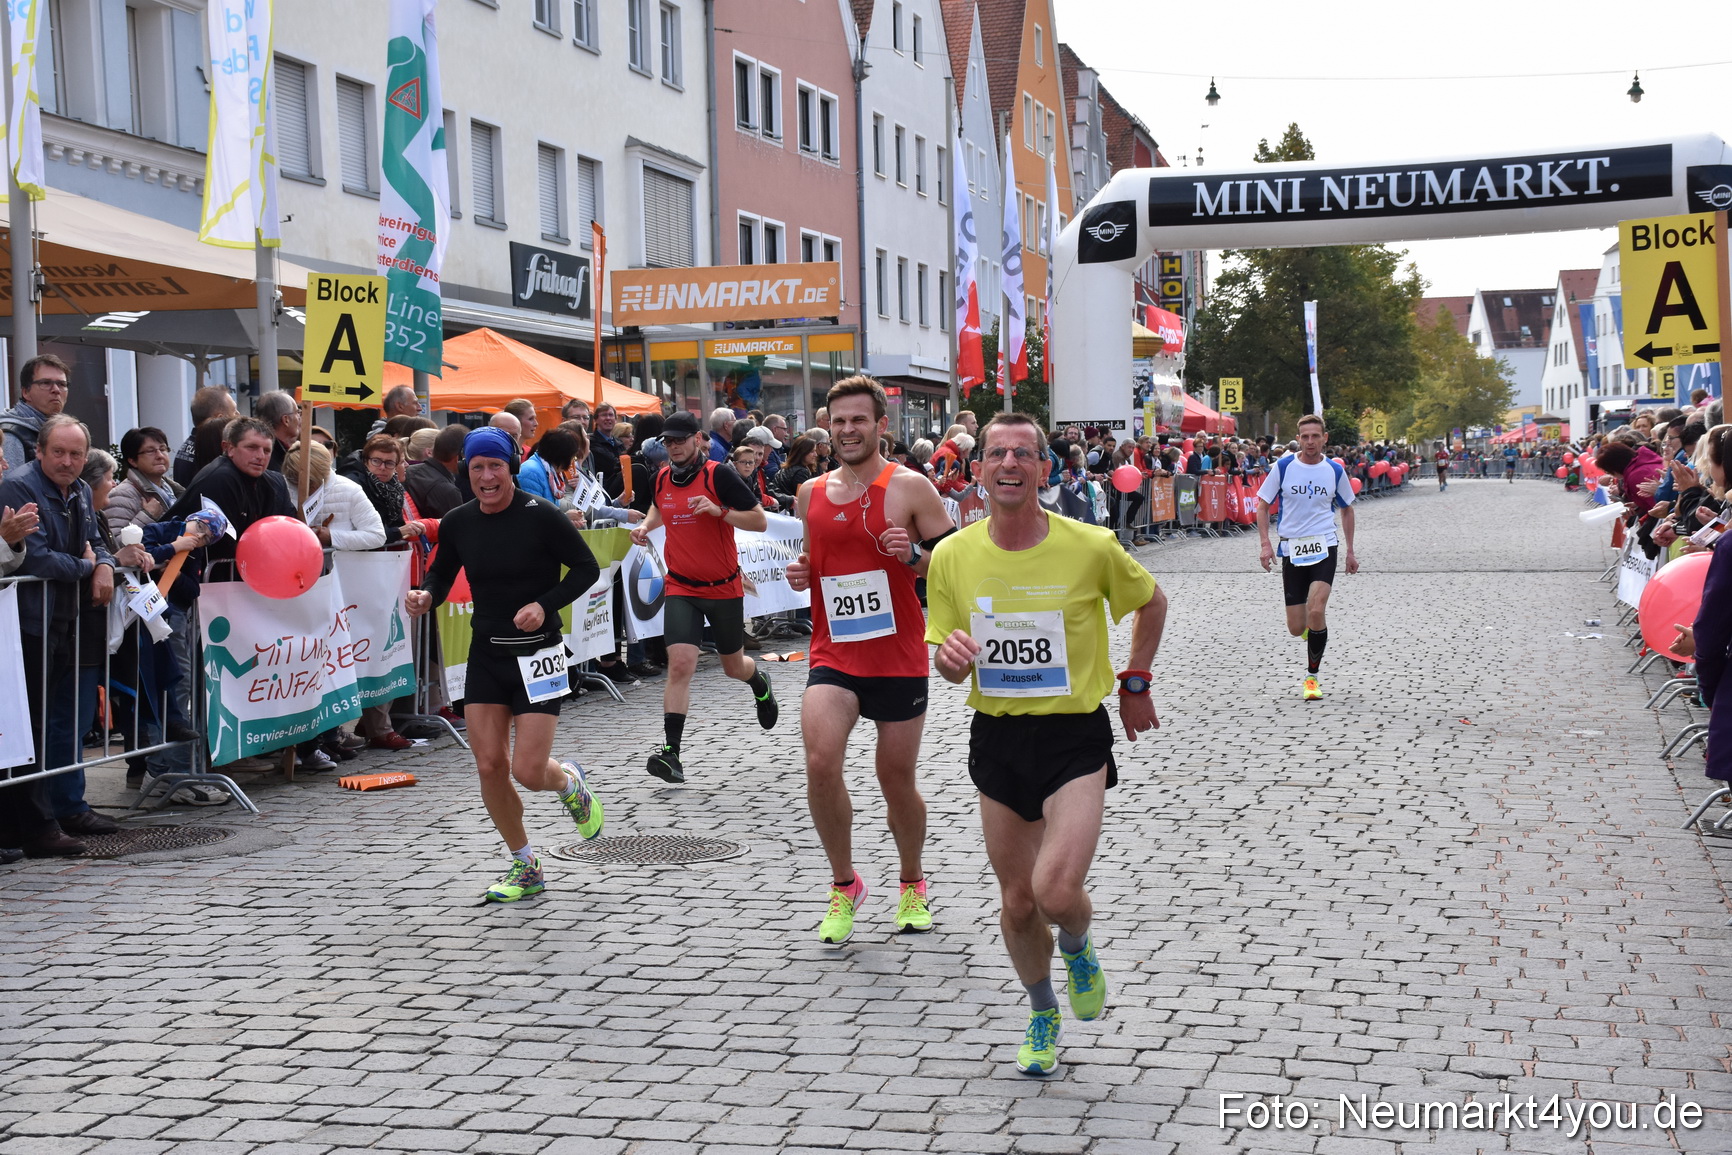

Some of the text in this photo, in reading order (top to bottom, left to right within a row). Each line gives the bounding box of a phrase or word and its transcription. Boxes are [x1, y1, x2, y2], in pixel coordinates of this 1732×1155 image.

[1192, 156, 1620, 217] MINI NEUMARKT.
[1712, 191, 1731, 200] MINI
[1631, 219, 1716, 252] Block
[317, 278, 379, 304] Block
[620, 277, 829, 313] RUNMARKT.DE
[1645, 261, 1708, 334] A
[320, 313, 366, 375] A
[714, 341, 793, 354] RUNMARKT.DE
[1225, 389, 1237, 405] B
[1376, 425, 1383, 434] C
[1294, 542, 1322, 557] 2446
[843, 578, 867, 587] BOCK
[833, 591, 881, 616] 2915
[1004, 620, 1036, 629] BOCK
[985, 638, 1052, 664] 2058
[530, 653, 565, 679] 2032
[1000, 672, 1043, 683] Jezussek
[246, 722, 310, 745] Service-Line:
[331, 699, 350, 715] 63
